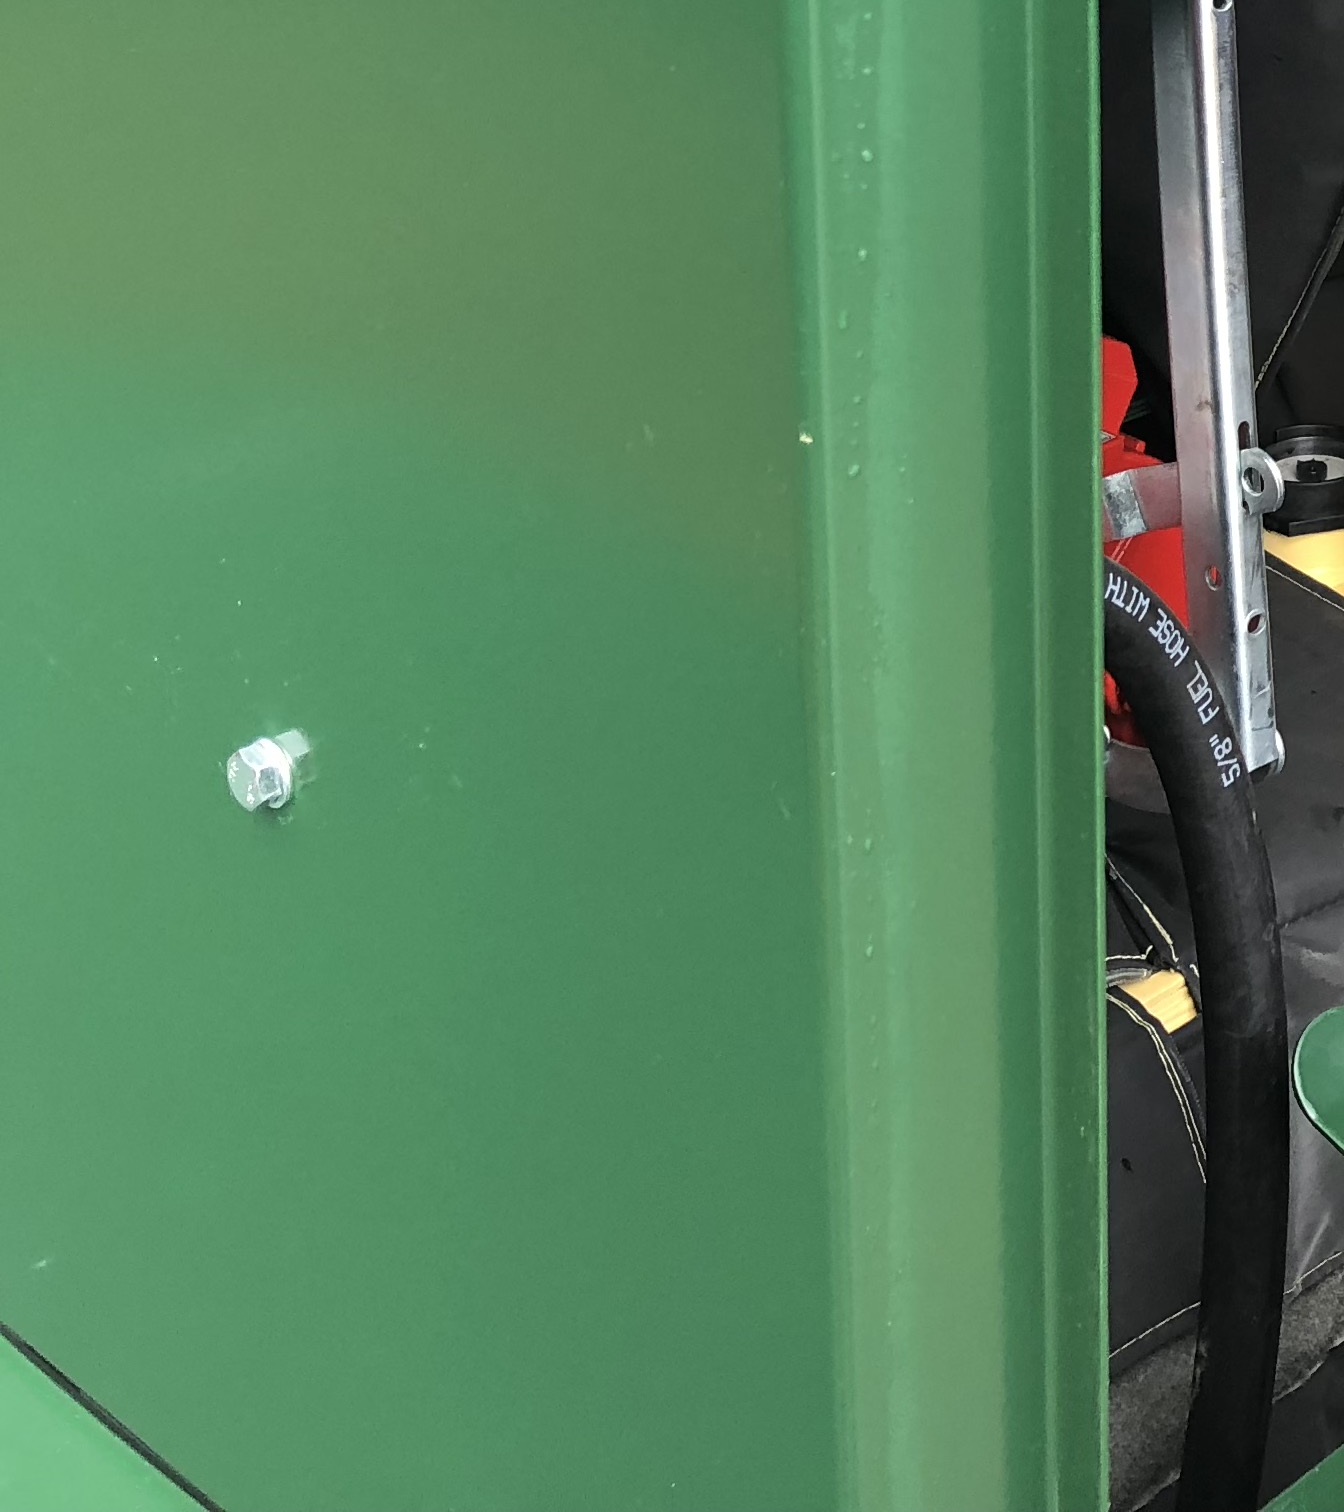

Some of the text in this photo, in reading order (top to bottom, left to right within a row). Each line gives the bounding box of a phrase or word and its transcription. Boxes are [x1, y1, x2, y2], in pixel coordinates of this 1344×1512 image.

[1104, 572, 1241, 788] 5/8" FUEL HOSE WITH
